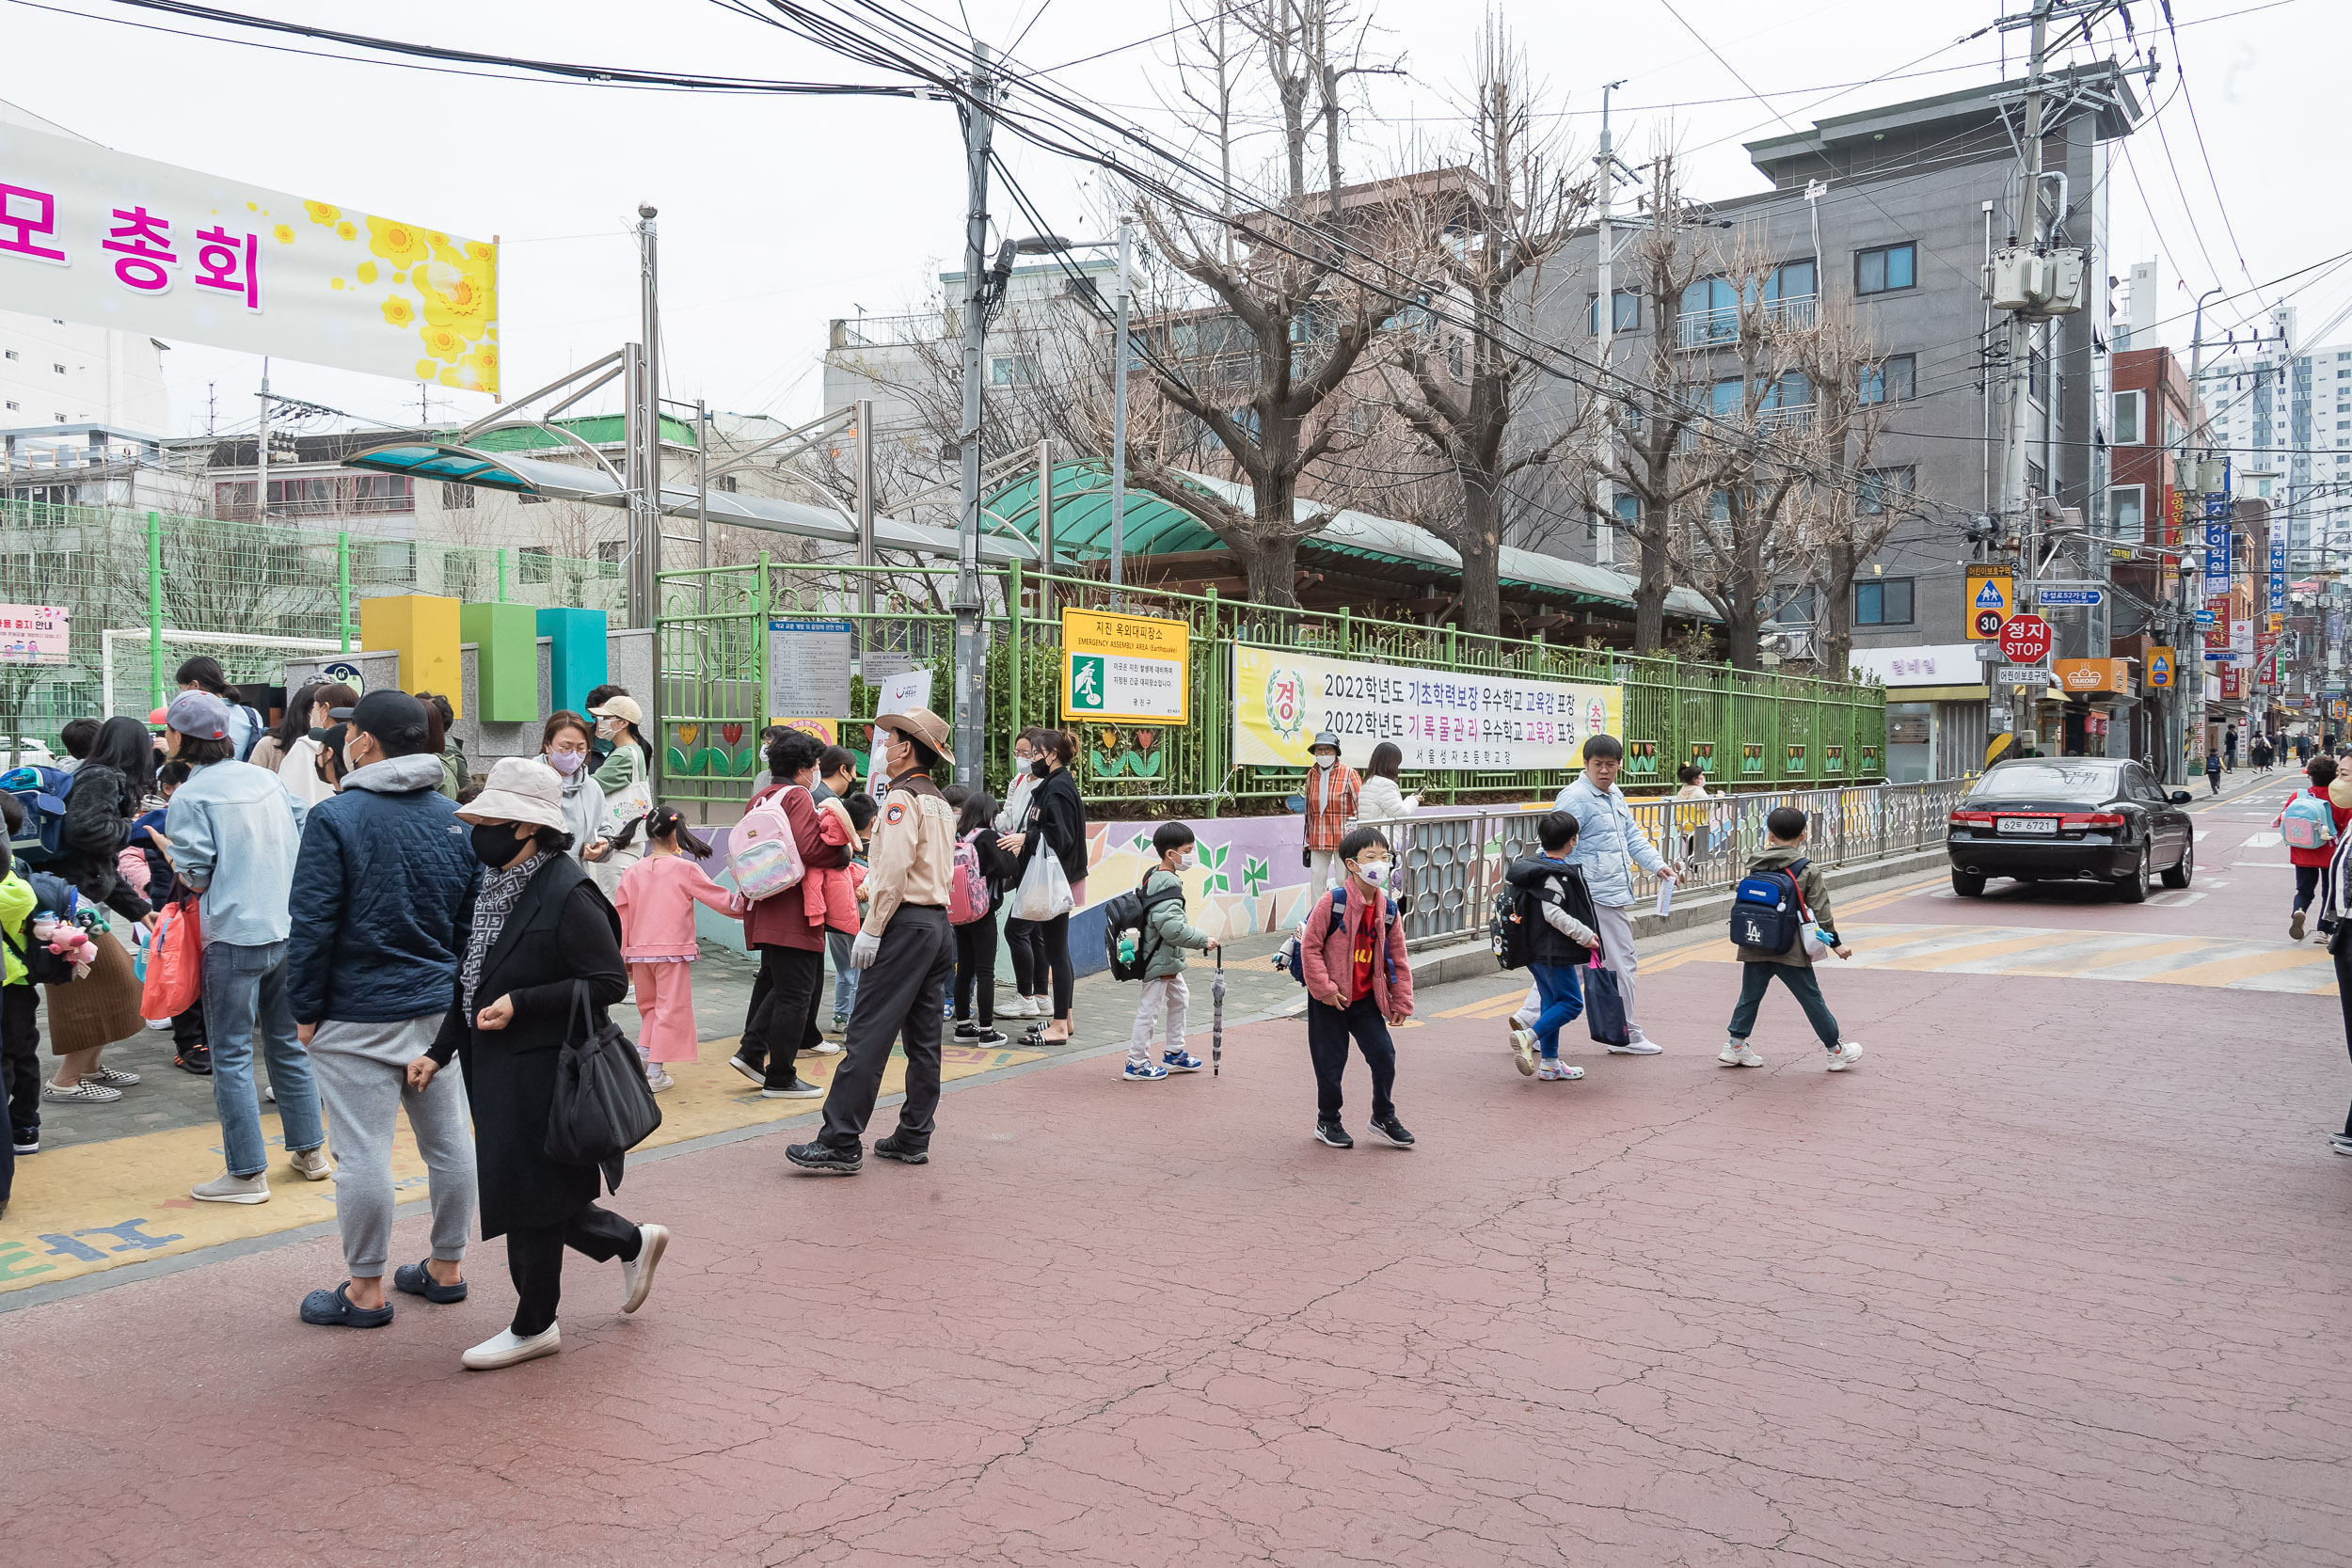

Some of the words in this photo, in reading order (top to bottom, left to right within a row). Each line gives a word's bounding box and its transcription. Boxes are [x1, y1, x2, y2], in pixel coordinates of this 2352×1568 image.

[102, 206, 259, 309] 총회
[1969, 566, 2010, 576] 어린이보호구역
[15, 620, 33, 629] 중지
[36, 621, 53, 630] 안내
[1096, 621, 1112, 635] 지진
[1116, 623, 1163, 640] 옥외대피장소
[1980, 617, 1997, 630] 30
[2008, 622, 2044, 639] 정지
[1078, 637, 1109, 647] EMERGENCY
[1110, 641, 1135, 650] ASSEMBLY
[1136, 642, 1149, 651] AREA
[1150, 644, 1178, 654] (Earthquake)
[2006, 642, 2042, 656] STOP
[1114, 662, 1128, 671] 이곳은
[1129, 663, 1138, 673] 지진
[1140, 665, 1153, 673] 발생에
[1155, 666, 1173, 674] 대비하여
[2000, 671, 2048, 682] 어린이보호구역
[1114, 676, 1128, 685] 지정된
[1129, 677, 1138, 686] 긴급
[1140, 678, 1173, 688] 대피장소입니다.
[1276, 681, 1294, 720] 경
[1325, 673, 1404, 704] 2022학년도
[1408, 681, 1478, 711] 기초학력보장
[1482, 688, 1522, 713] 우수학교
[1526, 691, 1554, 715] 교육감
[1558, 693, 1575, 716] 표창
[1325, 710, 1404, 738] 2022학년도
[1408, 714, 1478, 742] 기록물관리
[1482, 719, 1522, 743] 우수학교
[1526, 721, 1554, 745] 교육장
[1558, 721, 1575, 745] 표창
[1590, 705, 1601, 734] 축
[2026, 821, 2050, 830] 6721
[1746, 920, 1761, 942] LA
